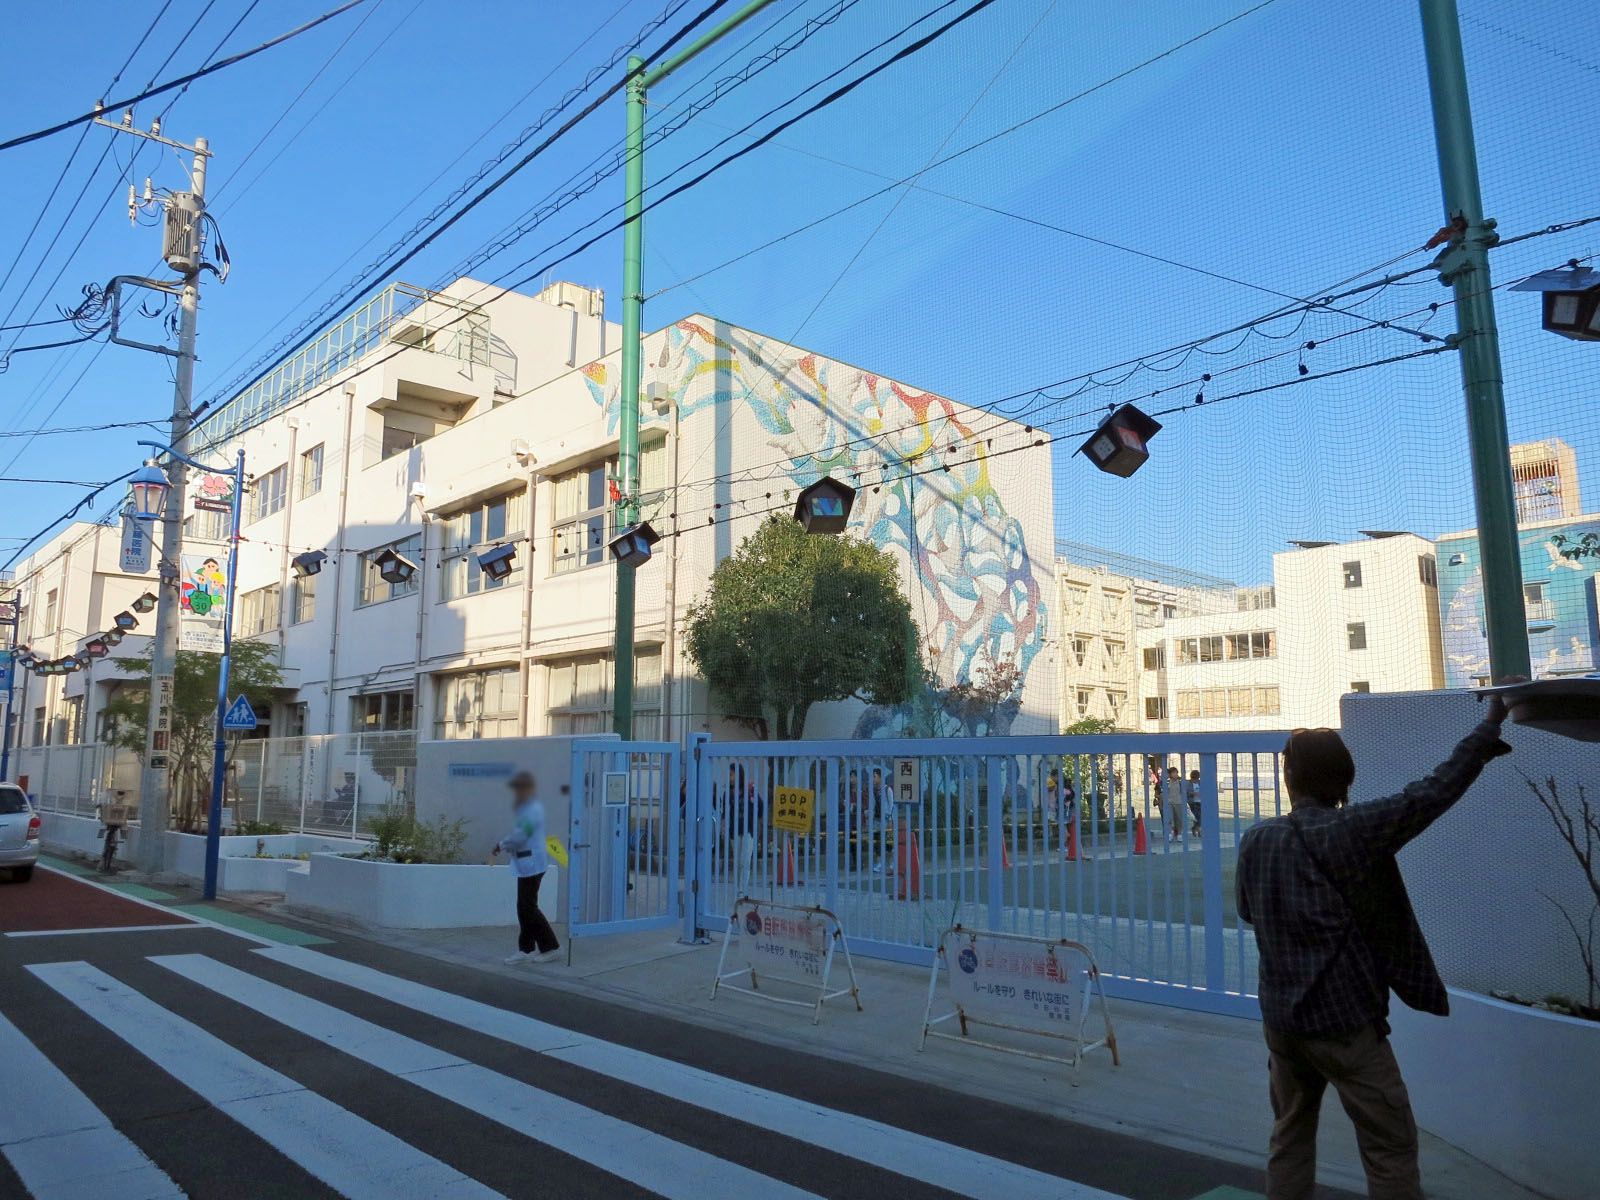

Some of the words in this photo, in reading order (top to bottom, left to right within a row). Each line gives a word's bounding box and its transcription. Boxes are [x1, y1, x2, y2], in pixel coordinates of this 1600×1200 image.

[158, 681, 169, 729] 玉川病院
[901, 761, 913, 799] 西門
[780, 793, 807, 806] BOP
[973, 981, 1016, 998] ルールを守り
